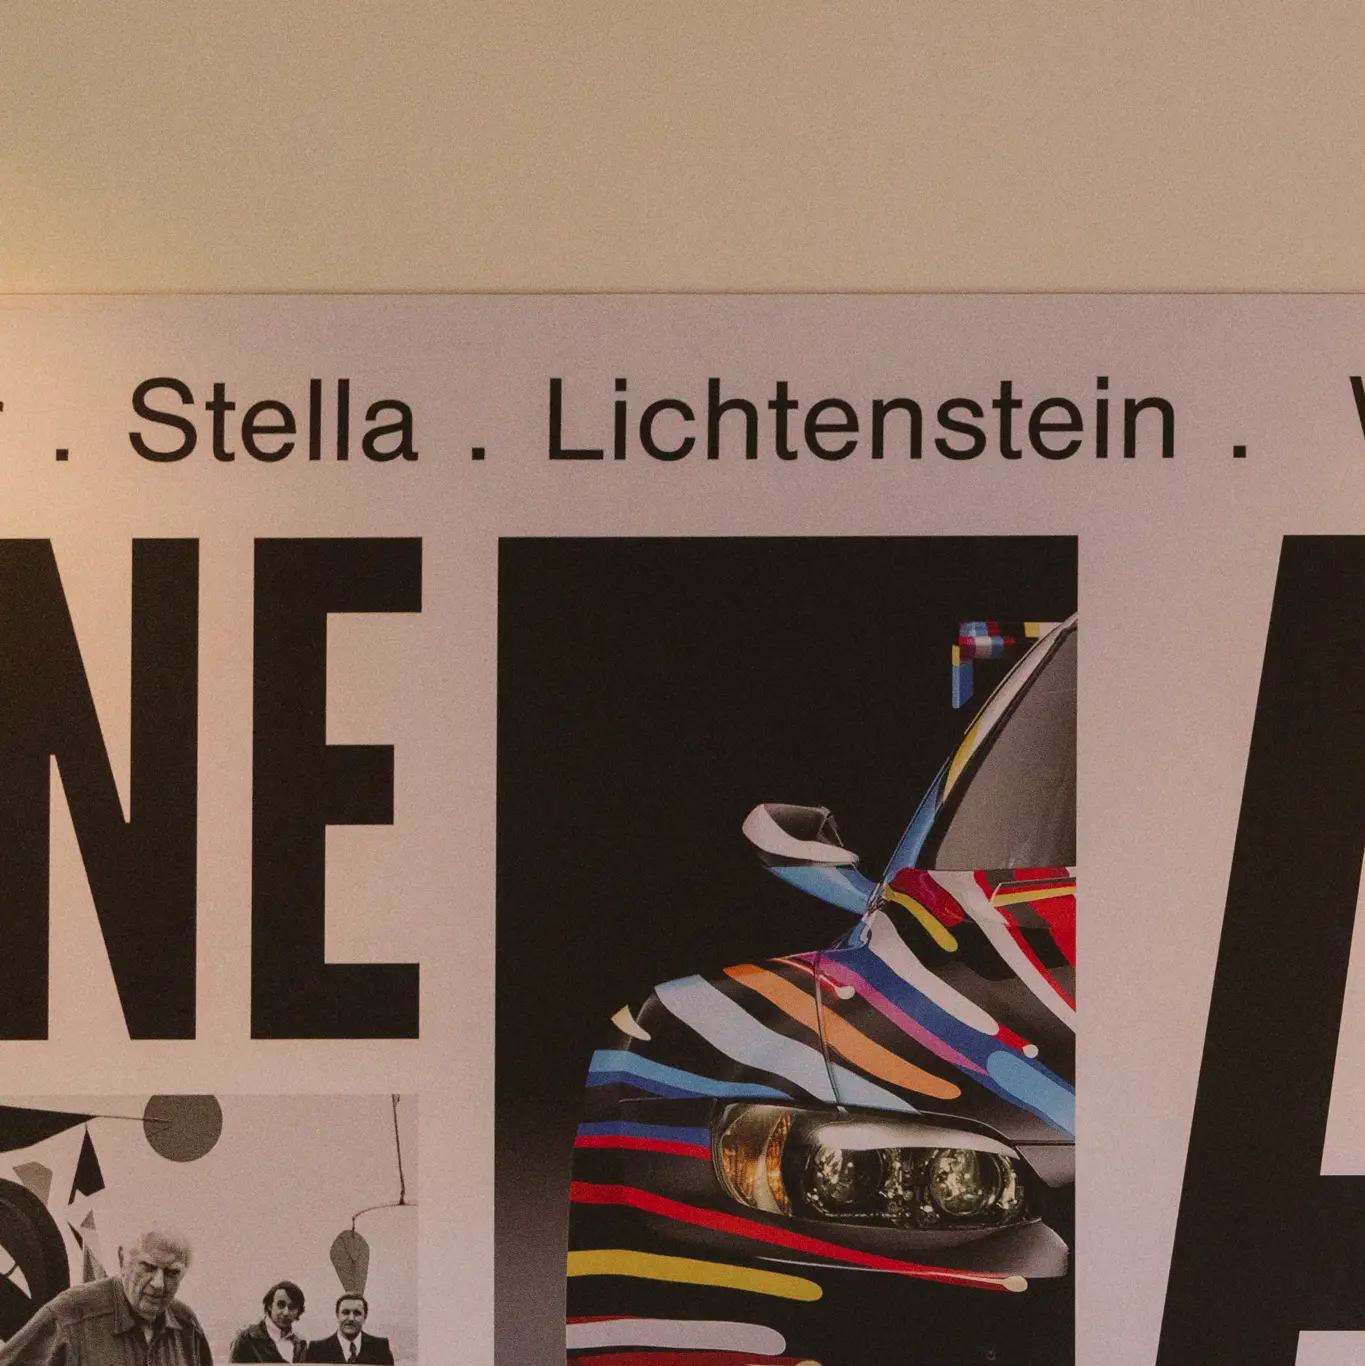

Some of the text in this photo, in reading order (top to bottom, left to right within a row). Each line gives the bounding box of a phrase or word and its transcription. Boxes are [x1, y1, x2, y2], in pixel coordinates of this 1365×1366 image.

[129, 377, 419, 463] Stella
[548, 377, 1175, 463] Lichtenstein
[0, 537, 423, 1041] NE
